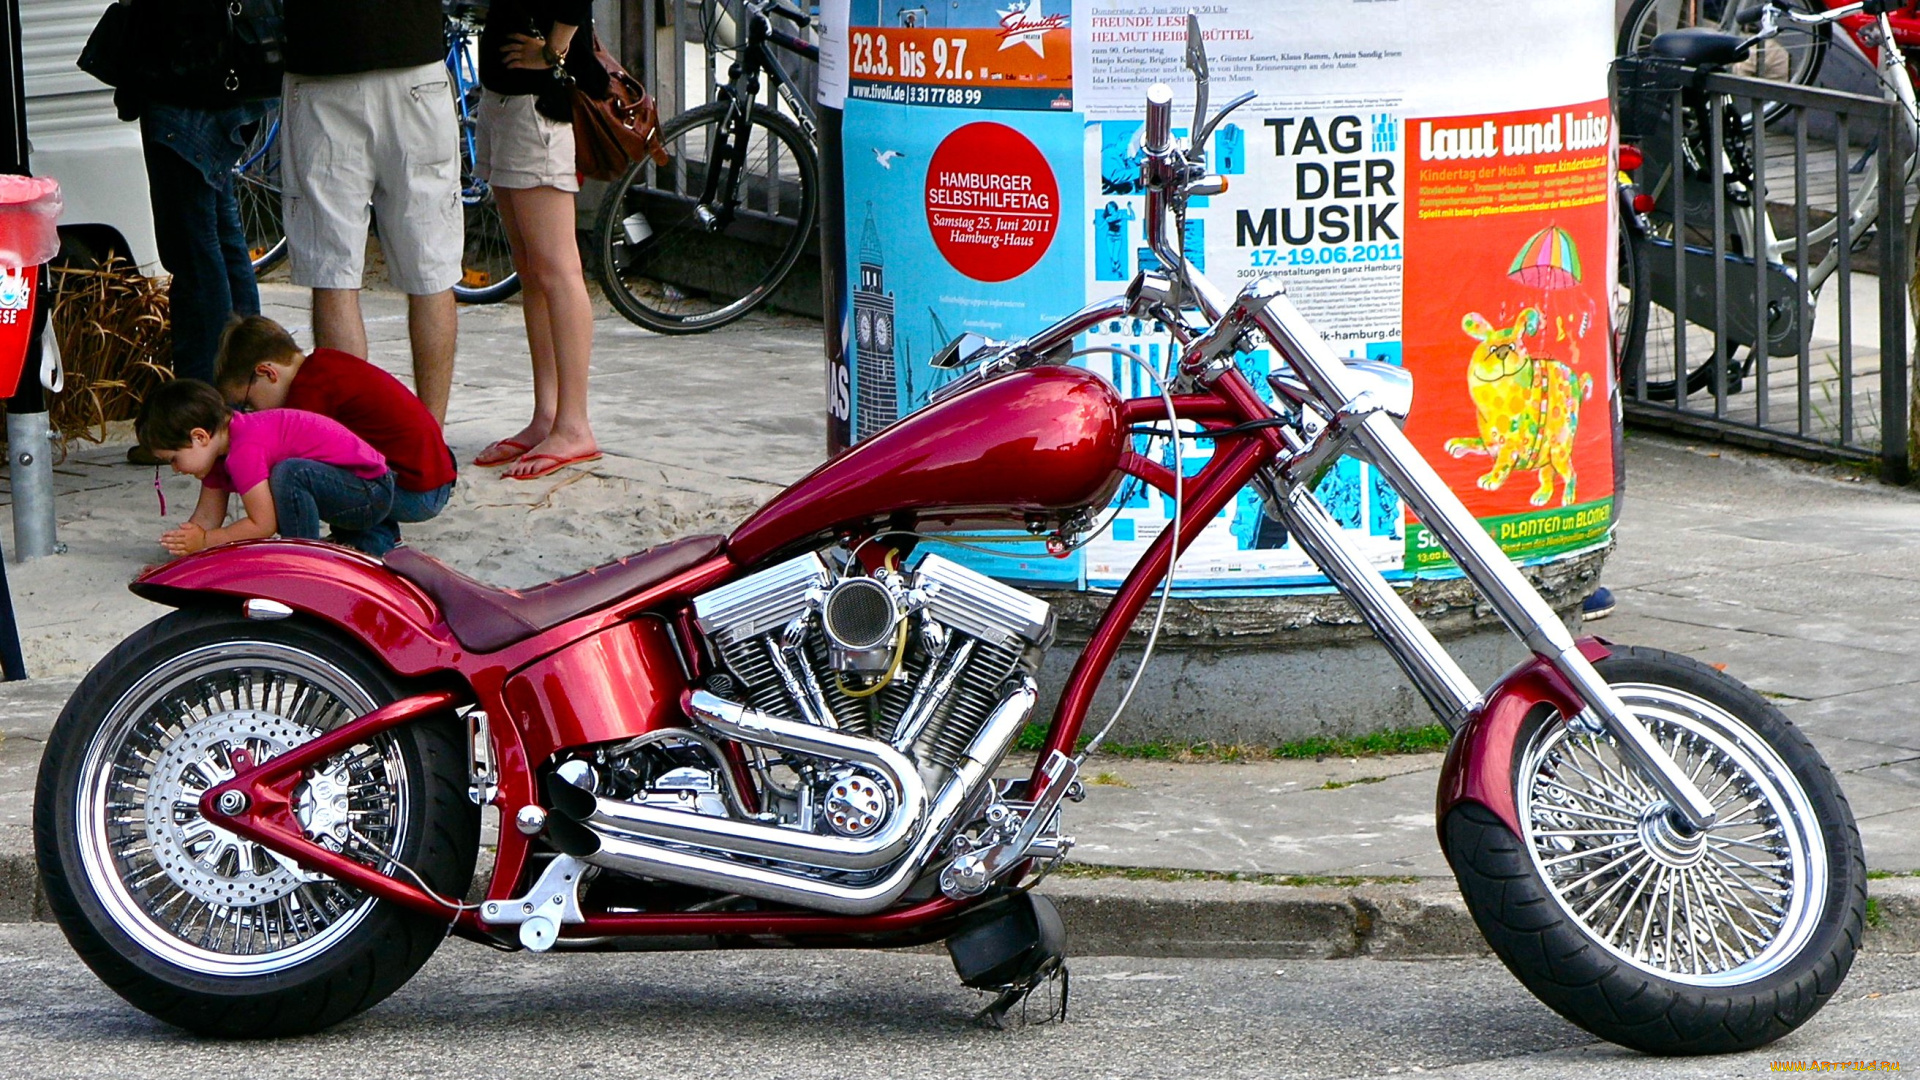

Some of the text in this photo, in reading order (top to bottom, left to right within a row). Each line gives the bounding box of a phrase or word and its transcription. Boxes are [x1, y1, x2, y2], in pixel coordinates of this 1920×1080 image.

[1212, 5, 1228, 14] Uhr
[996, 10, 1070, 38] Schmidt
[1091, 15, 1198, 28] FREUNDE LESE
[1091, 31, 1149, 43] HELMUT
[852, 32, 894, 77] 23.3.
[899, 41, 927, 78] bis
[932, 37, 973, 80] 9.7.
[1092, 56, 1115, 65] Hanjo
[1116, 56, 1147, 65] Kesting,
[1149, 55, 1178, 64] Brigitte
[1220, 54, 1248, 62] Günter
[1249, 54, 1279, 63] Kunert,
[1280, 52, 1302, 61] Klaus
[1303, 52, 1331, 60] Ramm,
[1333, 51, 1356, 59] Armin
[1109, 46, 1121, 54] 90.
[1122, 46, 1164, 55] Geburtstag
[1108, 65, 1161, 75] Lieblingstexte
[1162, 65, 1177, 73] und
[1233, 64, 1254, 72] ihren
[1255, 63, 1307, 73] Erinnerungen
[1320, 62, 1335, 70] den
[1336, 61, 1358, 69] Autor.
[1092, 75, 1105, 83] Ida
[1106, 75, 1157, 84] Heissenbüttel
[1159, 74, 1185, 85] spricht
[1228, 74, 1254, 82] Mann.
[852, 84, 905, 101] www.tivoli.de
[1264, 114, 1363, 157] TAG
[1420, 111, 1608, 162] laut und luise
[940, 171, 1032, 191] HAMBURGER
[1296, 158, 1396, 200] DER
[1419, 163, 1526, 182] Kindertag der Musik
[929, 188, 1049, 210] SELBSTHILFETAG
[1442, 208, 1454, 217] mit
[1455, 206, 1472, 216] beim
[933, 213, 1050, 233] Samstag 25. Juni 2011
[1236, 202, 1400, 247] MUSIK
[950, 229, 1034, 249] Hamburg-Haus
[1250, 243, 1403, 267] 17.-19.06.2011
[1237, 263, 1402, 278] 300 Veranstaltungen in ganz Hamburg
[0, 310, 17, 324] SE
[827, 358, 850, 422] AS
[1500, 516, 1561, 540] PLANTEN
[1562, 517, 1574, 530] un
[1575, 504, 1610, 528] BLOMEN
